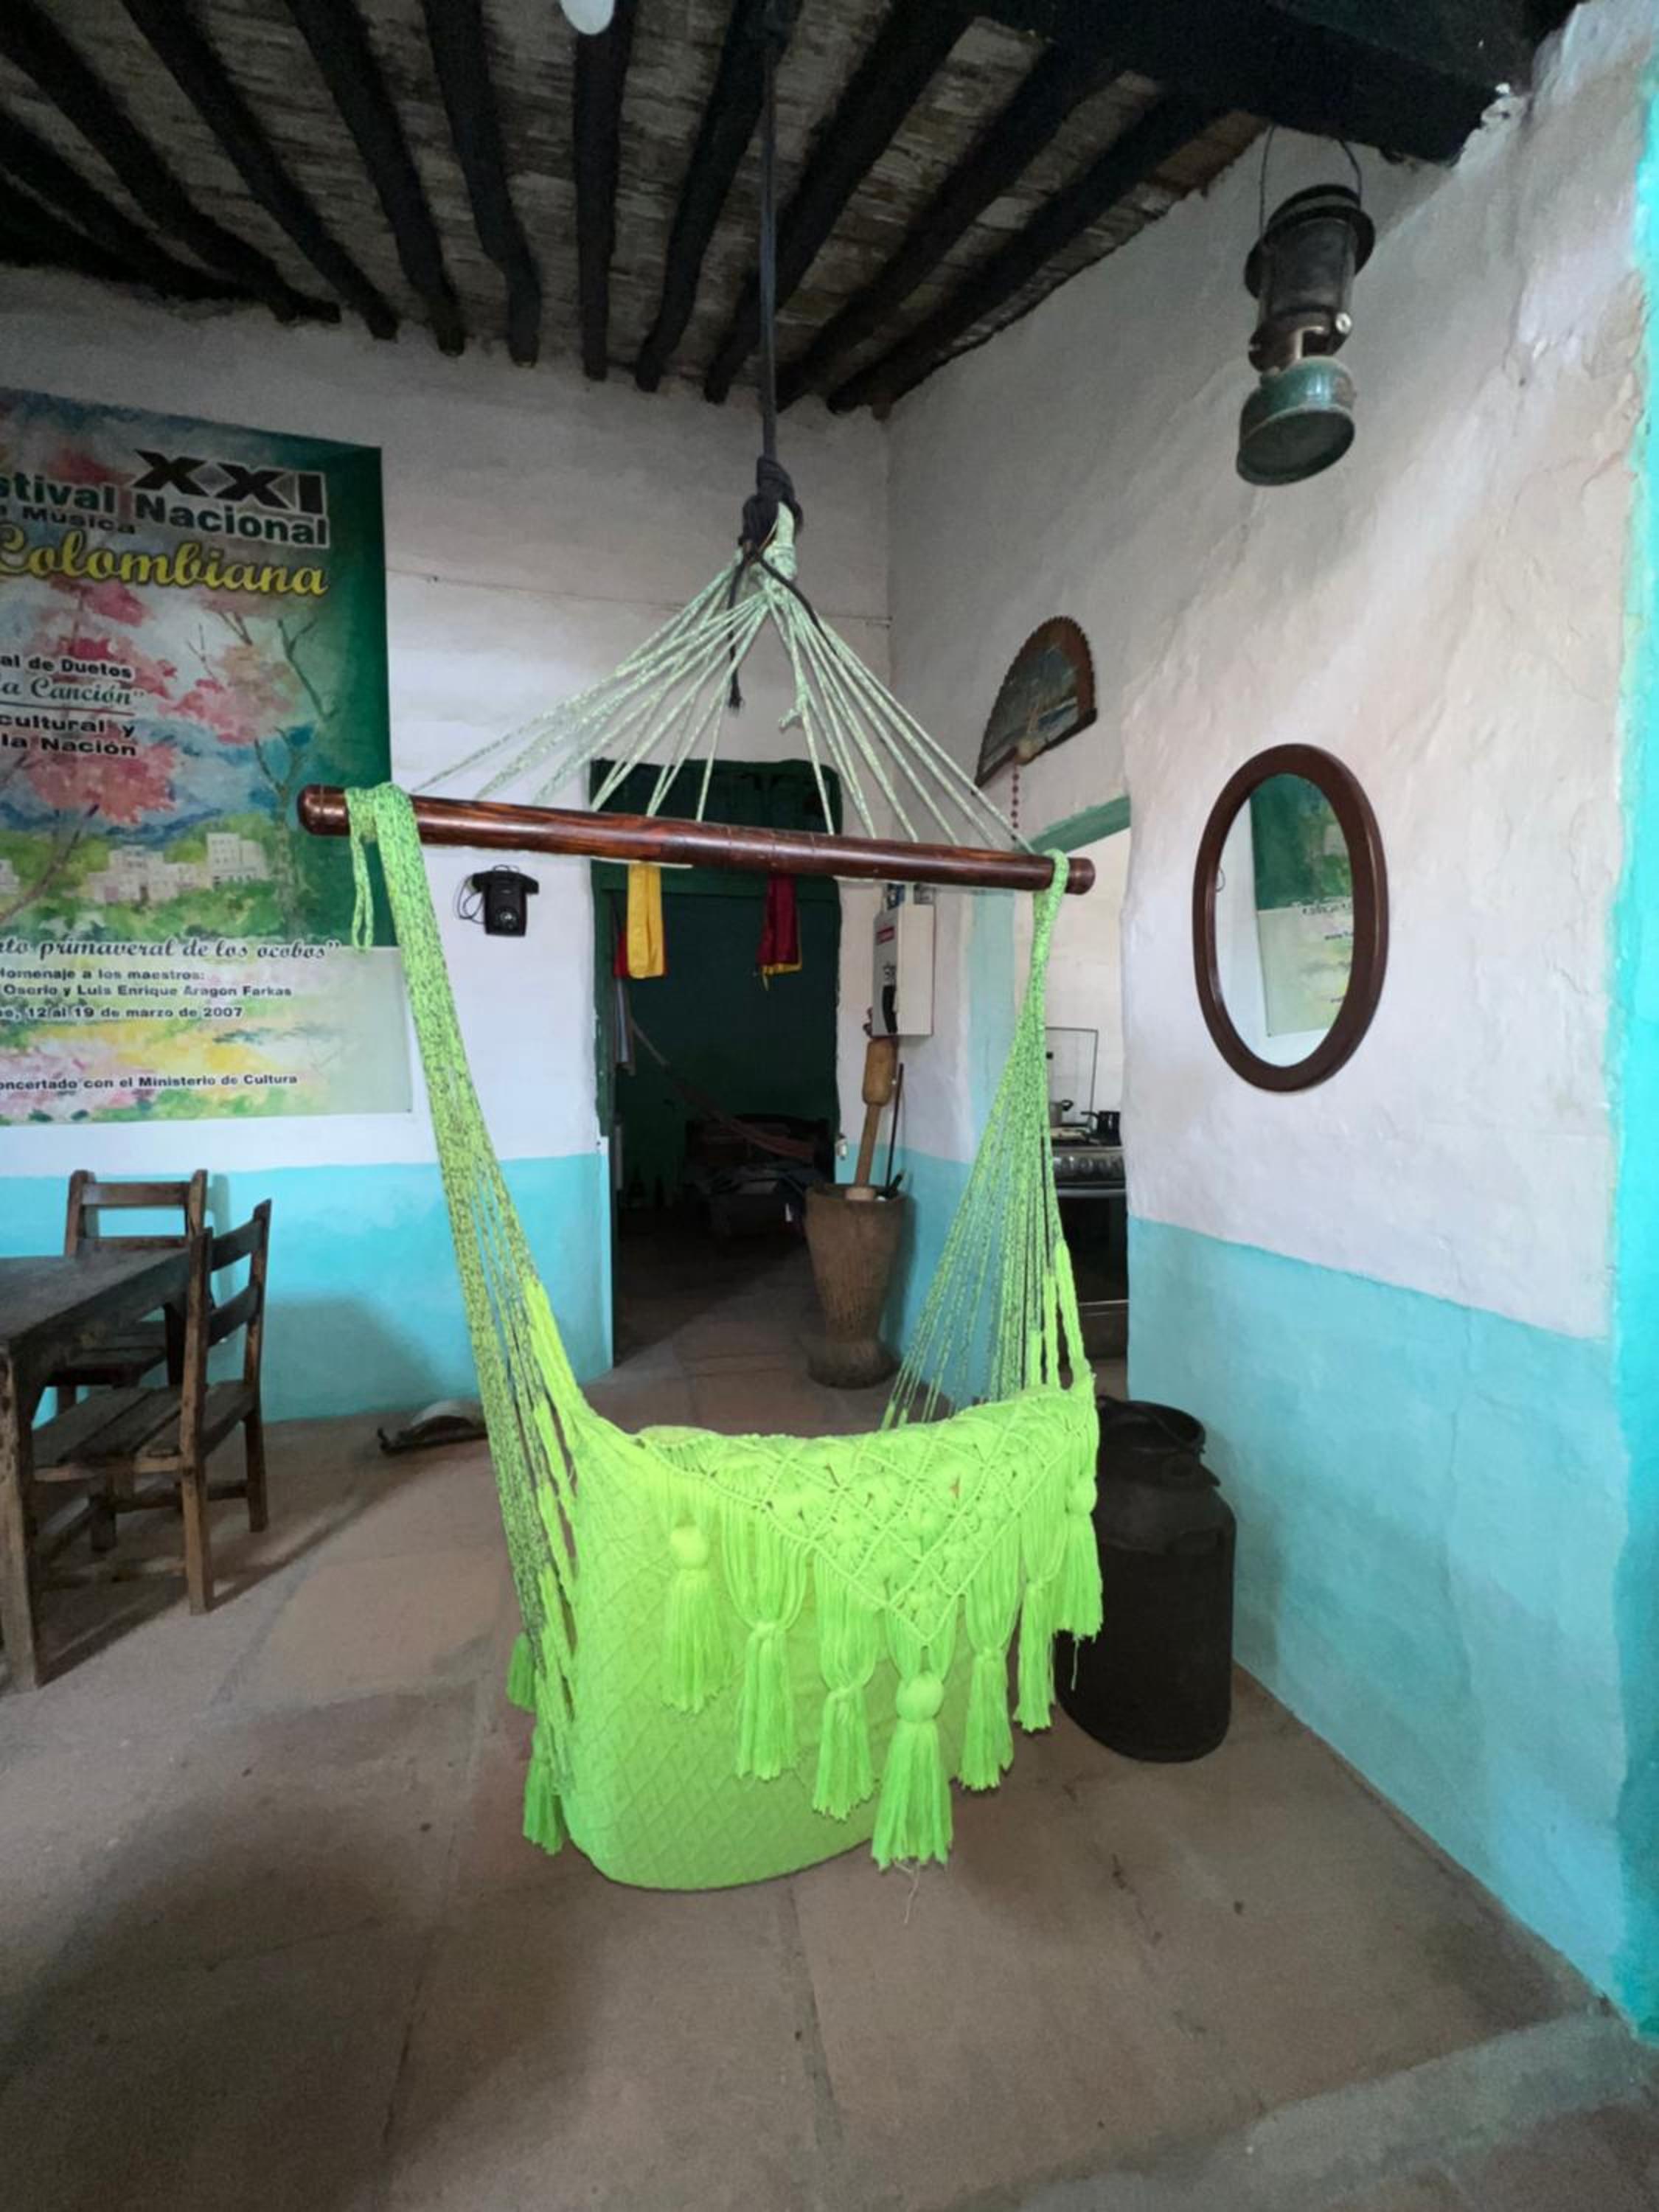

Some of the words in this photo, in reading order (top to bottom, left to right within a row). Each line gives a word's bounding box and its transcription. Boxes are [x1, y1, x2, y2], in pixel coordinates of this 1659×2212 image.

[131, 448, 323, 514] XXI
[136, 493, 327, 545] Nacional
[29, 658, 54, 672] de
[61, 658, 131, 678] Duetos
[0, 714, 105, 732] cultural
[122, 725, 134, 737] y
[2, 734, 27, 748] la
[41, 738, 136, 756] Nación
[40, 937, 174, 960] primaveral
[183, 939, 208, 956] de
[216, 939, 248, 956] los
[83, 970, 92, 979] a
[99, 969, 122, 979] los
[128, 968, 205, 980] maestros:
[4, 984, 58, 995] Osorio
[63, 987, 71, 996] y
[77, 984, 111, 995] Luis
[118, 984, 178, 997] Enrique
[243, 986, 292, 995] Farkas
[29, 1008, 46, 1018] 12
[53, 1008, 66, 1018] al
[75, 1007, 94, 1017] 19
[101, 1007, 119, 1017] de
[126, 1009, 173, 1017] marzo
[178, 1007, 197, 1017] de
[204, 1007, 243, 1017] 2007
[84, 1079, 114, 1088] con
[120, 1077, 132, 1087] el
[139, 1076, 215, 1087] Ministerio
[221, 1076, 237, 1085] de
[243, 1074, 297, 1085] Cultura
